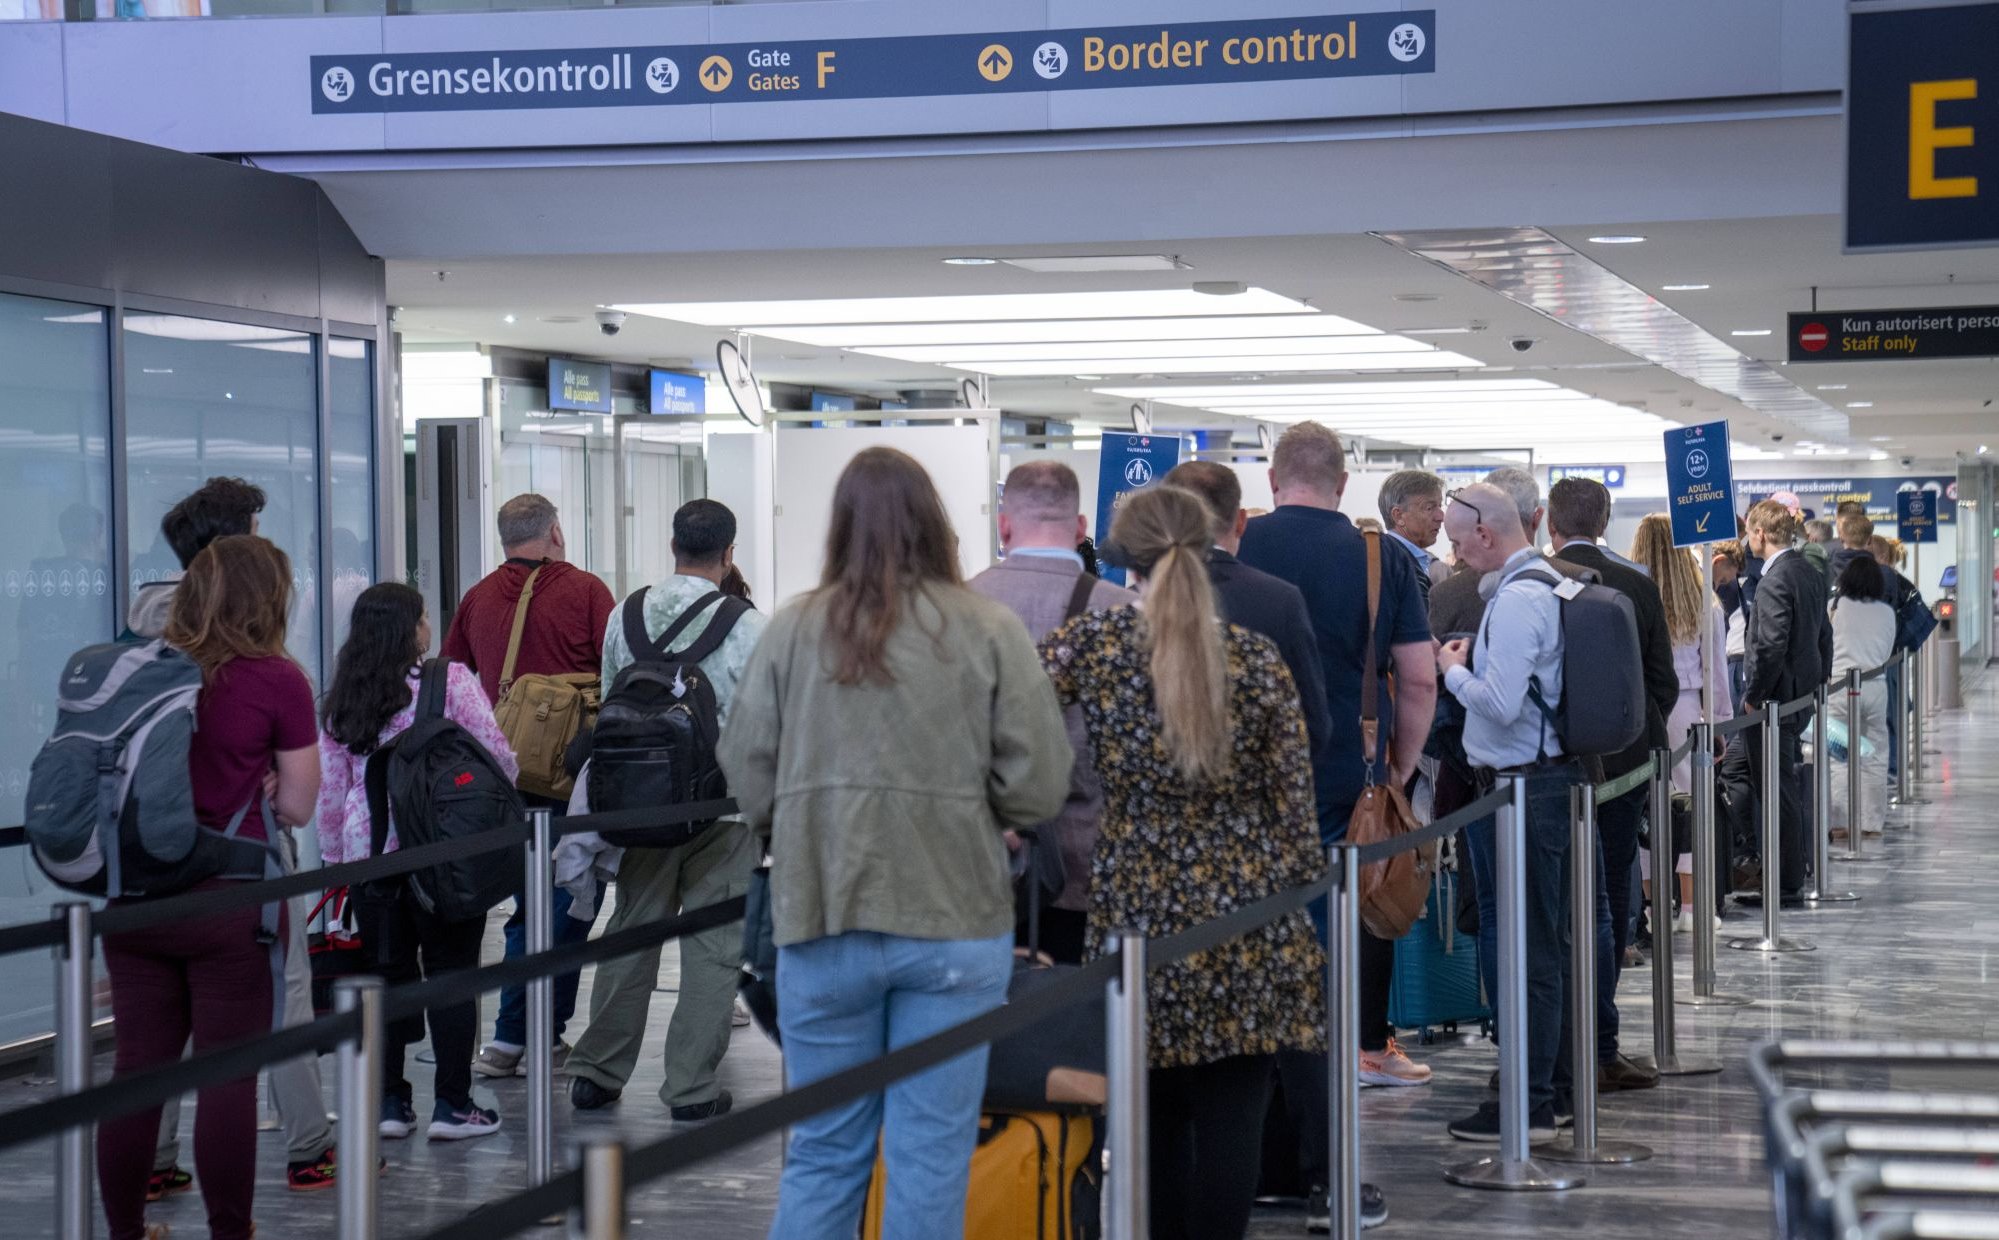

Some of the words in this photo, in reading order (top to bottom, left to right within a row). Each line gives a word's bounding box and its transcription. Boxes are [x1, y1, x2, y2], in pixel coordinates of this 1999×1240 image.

[1083, 31, 1209, 73] Border
[1222, 20, 1357, 65] control
[747, 48, 791, 68] Gate
[368, 53, 632, 98] Grensekontroll
[817, 51, 836, 89] F
[748, 72, 800, 92] Gates
[1908, 79, 1978, 201] E
[1842, 318, 1871, 333] Kun
[1875, 315, 1953, 332] autorisert
[1958, 316, 1999, 332] perso
[1842, 336, 1880, 351] Staff
[1884, 335, 1918, 353] only
[564, 370, 575, 385] Alle
[1690, 454, 1705, 465] 12+
[1688, 482, 1712, 494] ADULT
[1793, 481, 1852, 494] passkontroll
[1677, 496, 1694, 505] SELF
[1695, 490, 1725, 503] SERVICE
[1836, 491, 1873, 503] control
